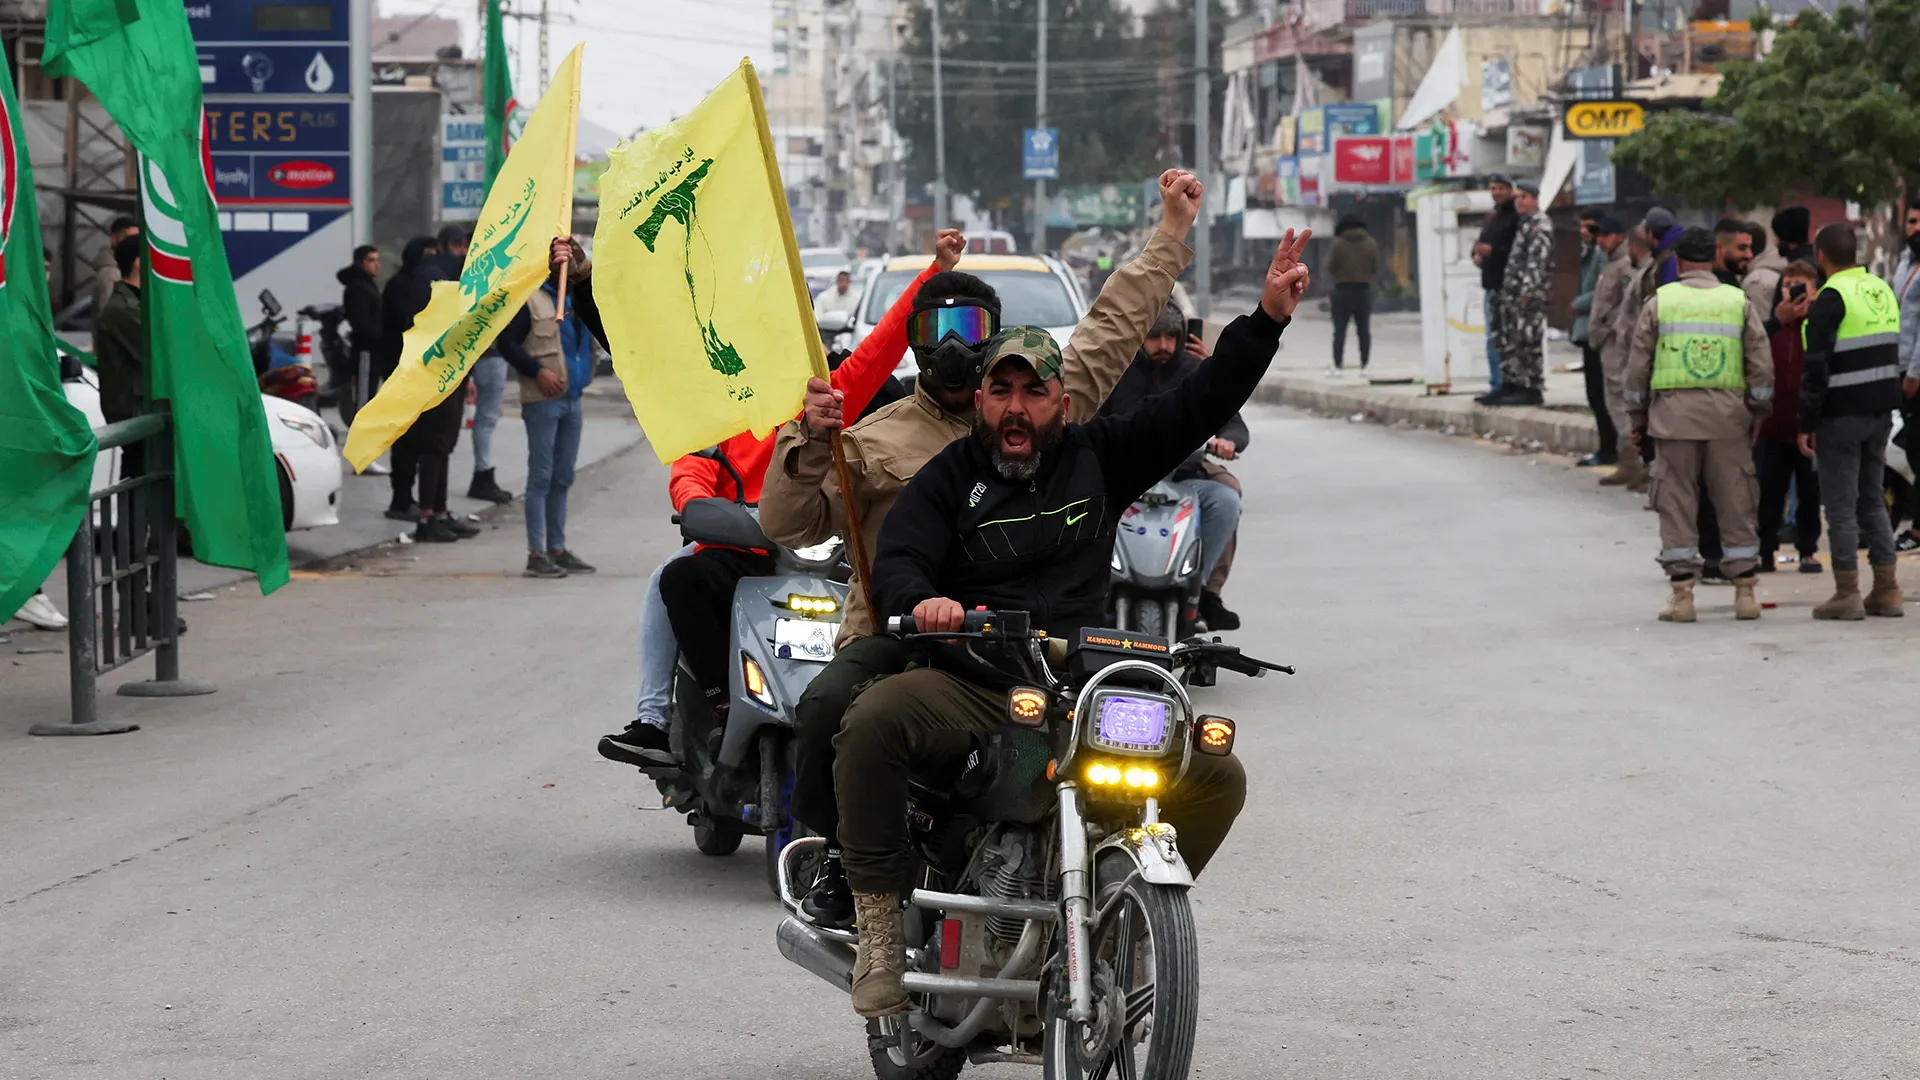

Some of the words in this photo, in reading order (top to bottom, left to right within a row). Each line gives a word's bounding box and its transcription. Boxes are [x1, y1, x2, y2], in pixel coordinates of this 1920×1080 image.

[1577, 108, 1637, 130] OMT
[500, 203, 522, 225] حزب
[1086, 635, 1121, 647] HAMMOUD
[1132, 641, 1167, 652] HAMMOUD
[1070, 942, 1078, 982] HAMMOUD
